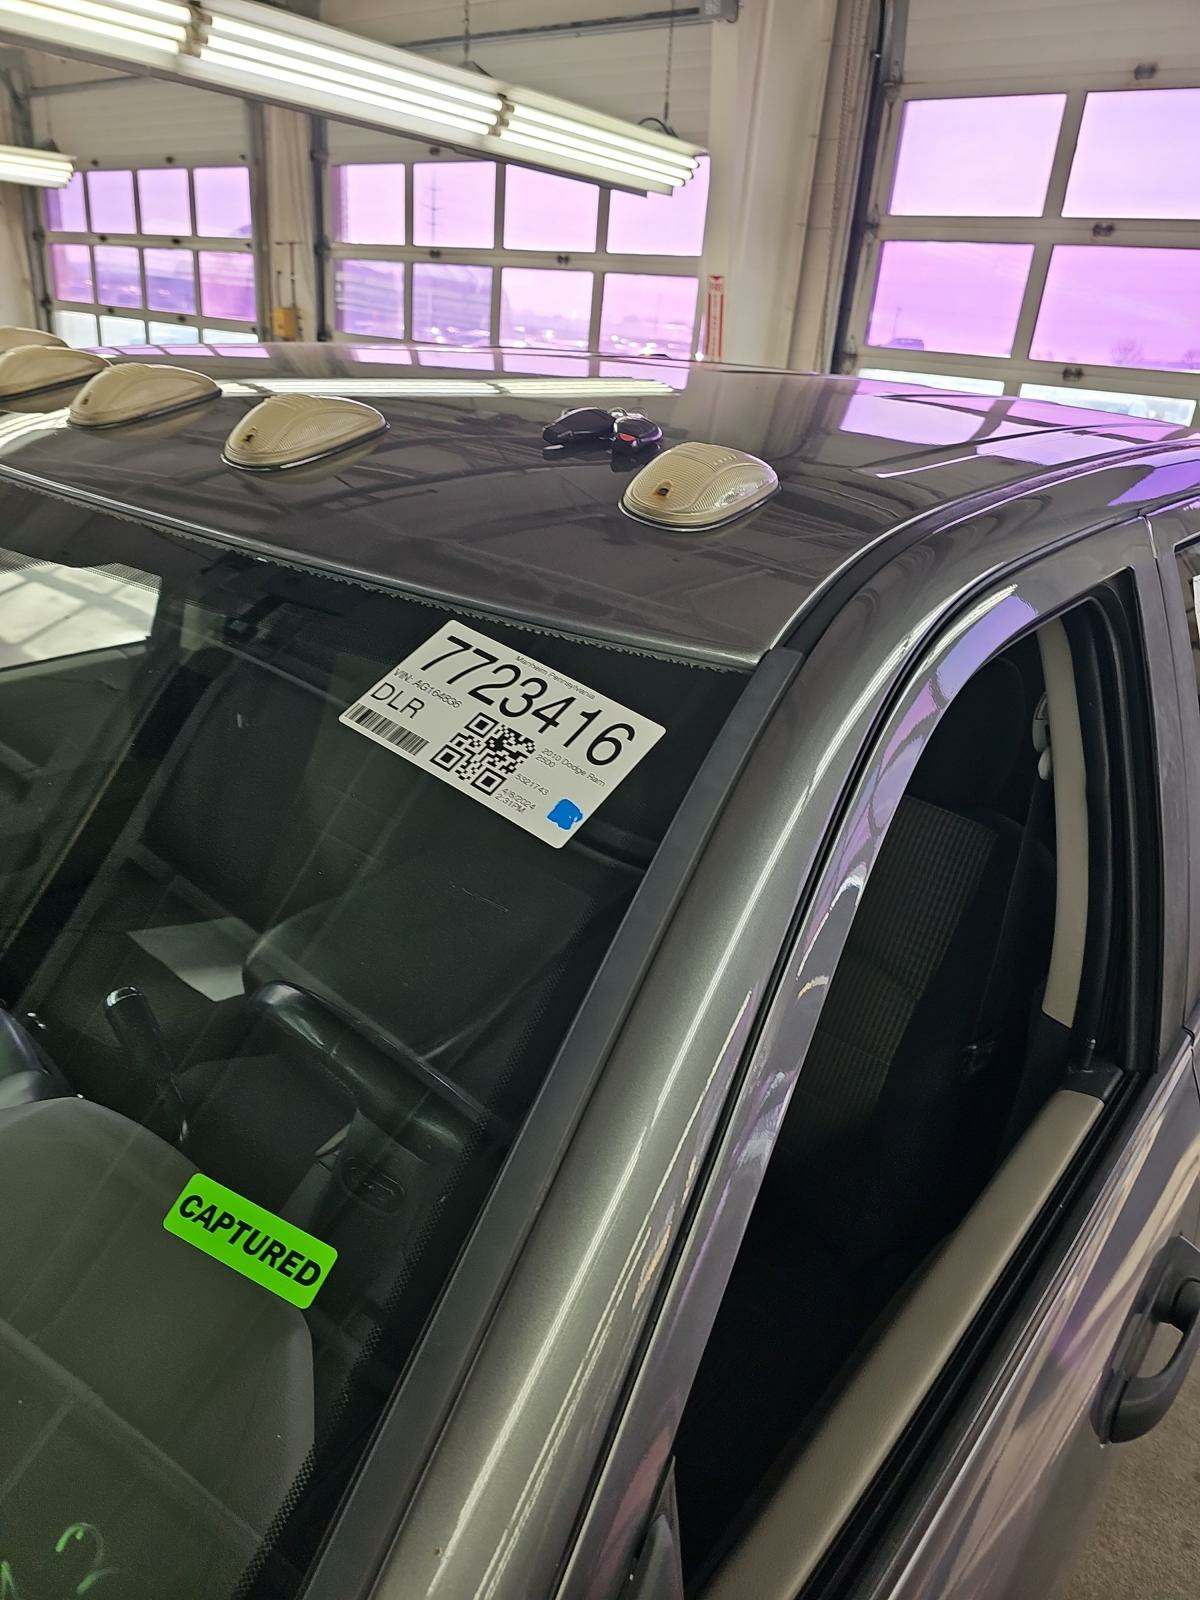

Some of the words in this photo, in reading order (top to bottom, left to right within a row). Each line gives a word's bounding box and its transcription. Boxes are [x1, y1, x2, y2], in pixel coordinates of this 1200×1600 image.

[393, 668, 414, 684] VIN:
[516, 656, 548, 676] Manheim
[548, 673, 596, 699] Pennsylvania
[370, 682, 424, 719] DLR
[420, 636, 635, 765] 7723416
[535, 754, 558, 768] 2500
[542, 748, 563, 762] 2010
[562, 759, 587, 776] Dodge
[586, 773, 606, 786] Ram
[179, 1195, 321, 1286] CAPTURED
